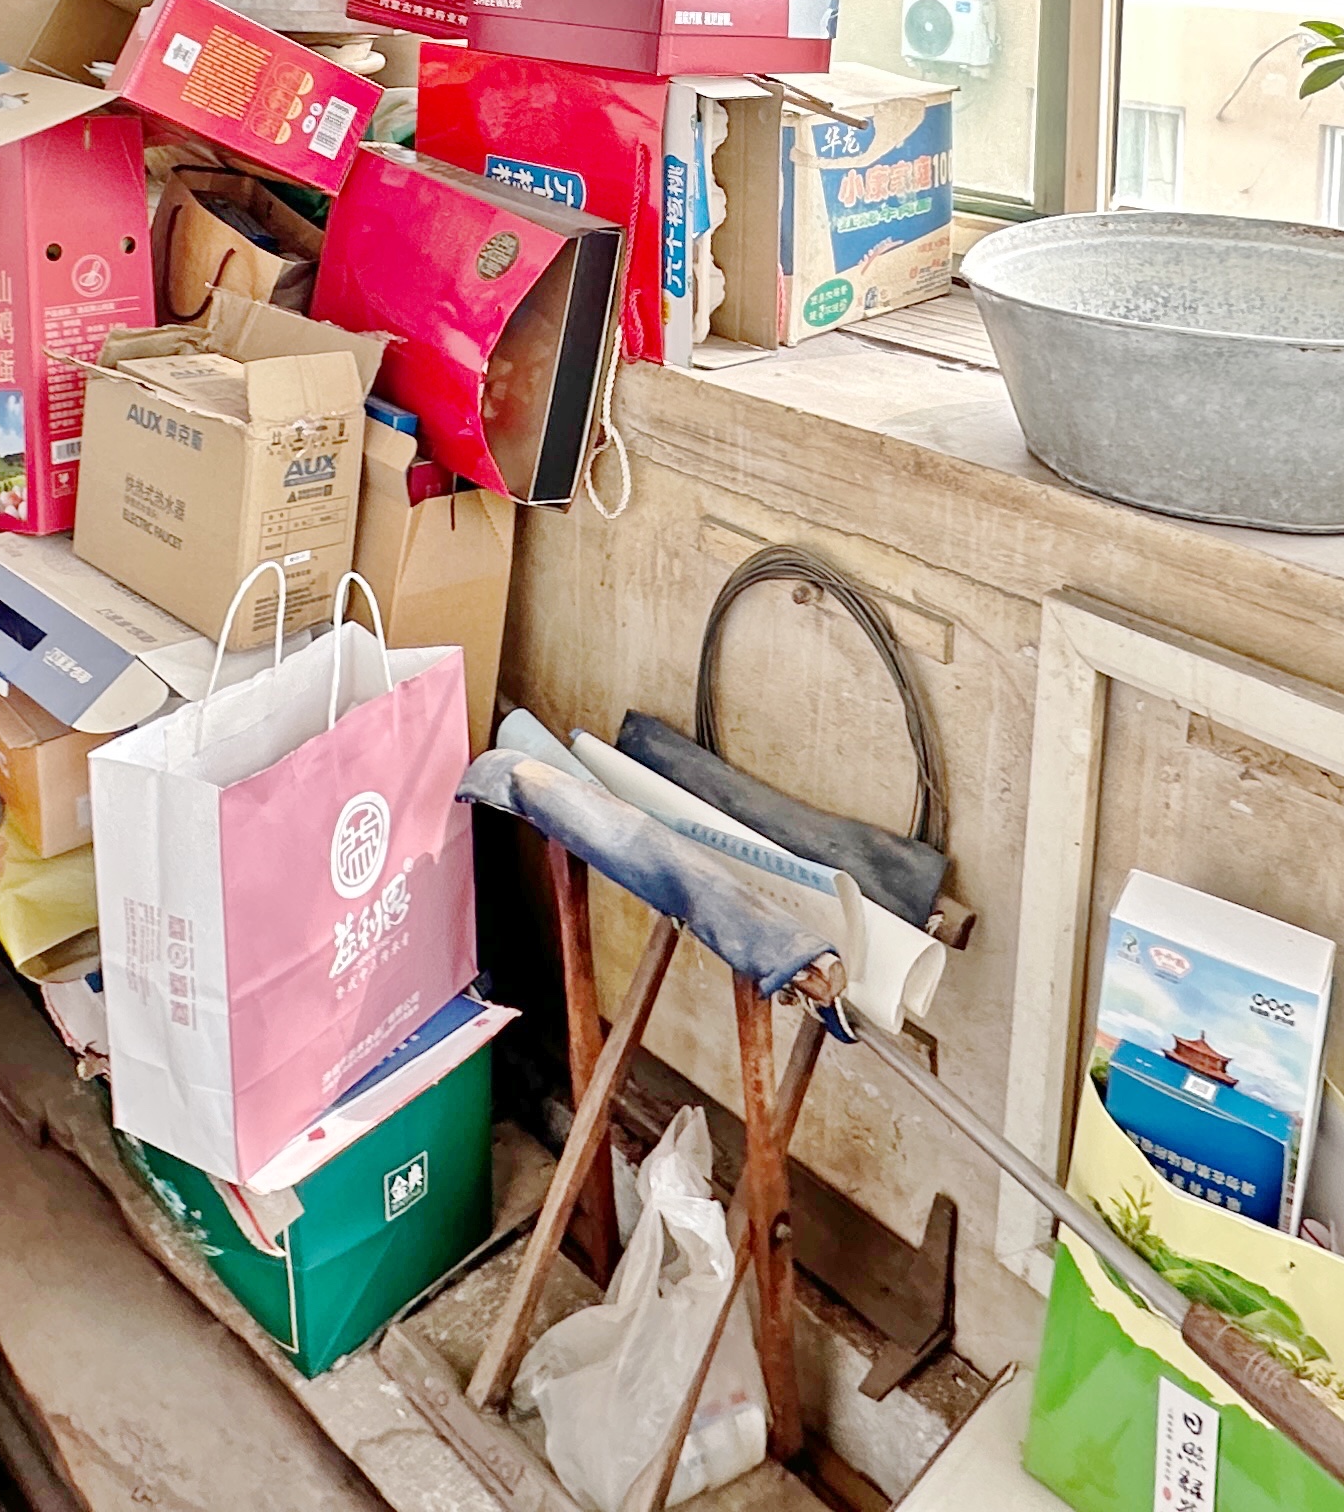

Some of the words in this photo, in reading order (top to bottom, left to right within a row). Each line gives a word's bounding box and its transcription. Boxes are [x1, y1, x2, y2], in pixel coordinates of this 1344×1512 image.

[820, 125, 860, 157] 华龙
[665, 164, 685, 290] 六个核桃
[126, 403, 163, 436] AUX
[285, 452, 337, 480] AUX
[389, 1163, 425, 1203] 金典
